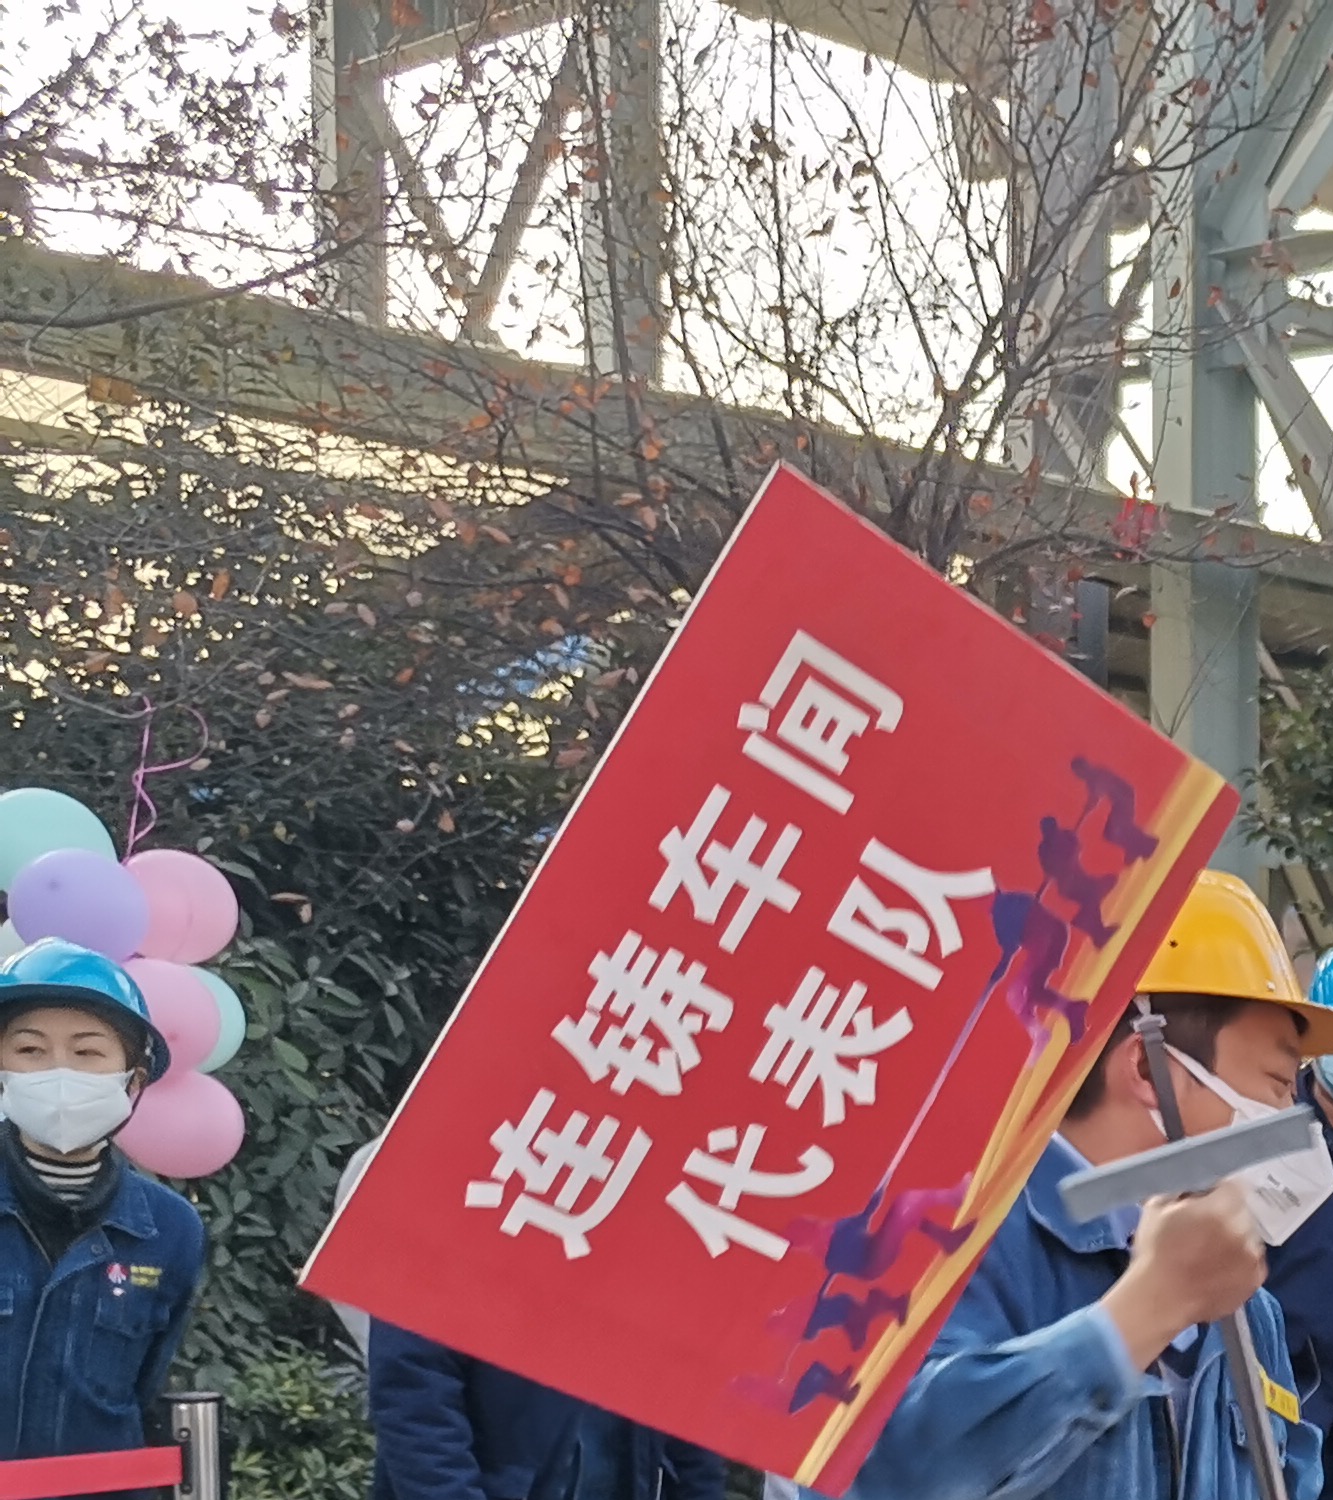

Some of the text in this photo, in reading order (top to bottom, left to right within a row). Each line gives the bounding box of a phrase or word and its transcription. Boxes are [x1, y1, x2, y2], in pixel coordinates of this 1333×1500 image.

[464, 629, 904, 1260] 连铸车间
[665, 837, 995, 1261] 代表队
